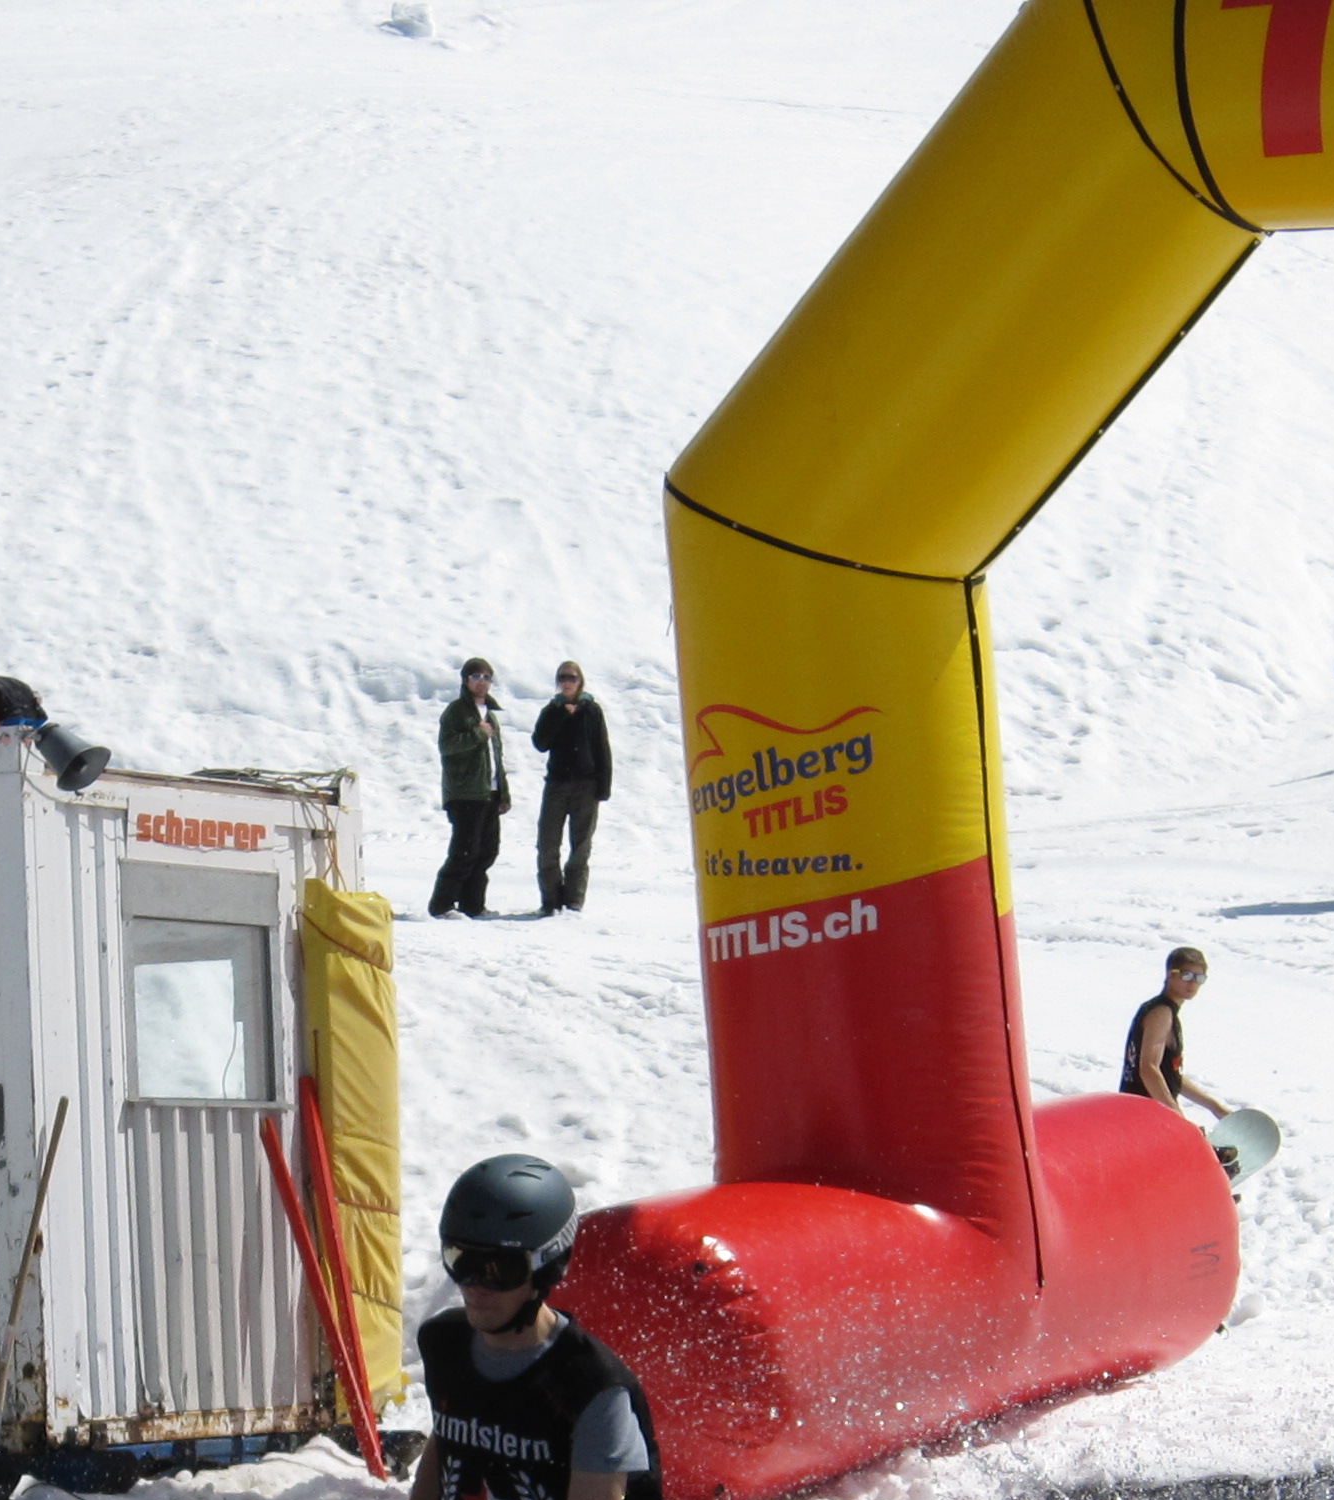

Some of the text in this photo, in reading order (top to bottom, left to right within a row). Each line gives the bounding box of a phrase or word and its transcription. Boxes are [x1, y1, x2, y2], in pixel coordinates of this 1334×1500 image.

[692, 732, 874, 815] engelberg
[136, 809, 266, 851] schaerer
[742, 784, 850, 839] TITLIS
[705, 849, 864, 877] it's heaven.
[707, 898, 879, 963] TITLIS.ch
